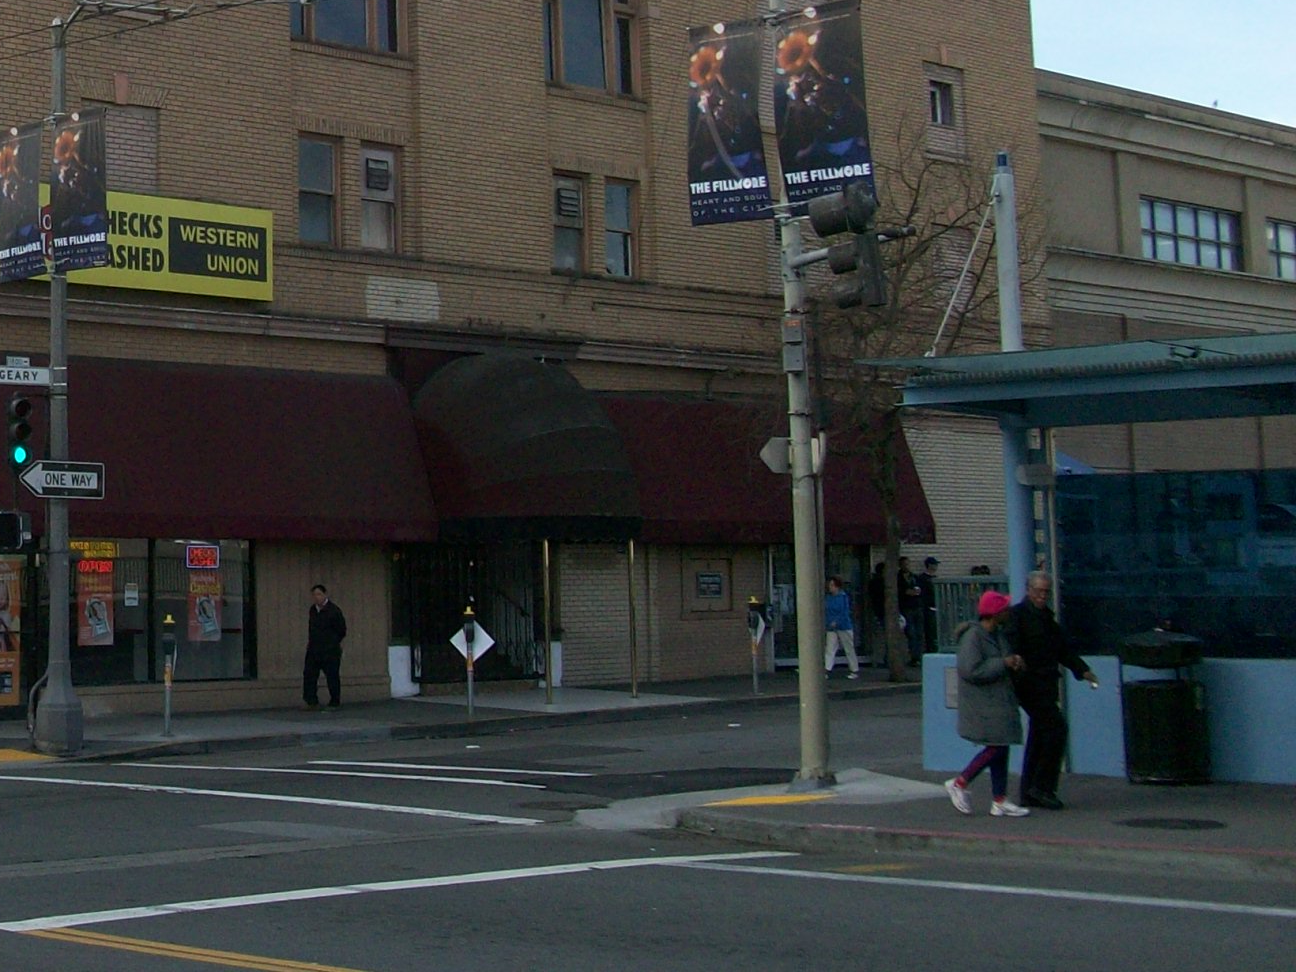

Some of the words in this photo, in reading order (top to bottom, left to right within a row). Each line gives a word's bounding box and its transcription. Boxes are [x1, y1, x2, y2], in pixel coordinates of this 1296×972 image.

[785, 171, 810, 185] THE
[810, 162, 872, 181] FILLMORE
[689, 182, 711, 195] THE
[712, 176, 768, 192] FILLMORE
[789, 187, 819, 197] HEART
[823, 184, 842, 192] AND
[692, 197, 719, 207] HEART
[722, 195, 741, 203] AND
[744, 193, 769, 201] SOUL
[106, 210, 164, 239] HECKS
[180, 224, 259, 250] WESTERN
[54, 237, 68, 247] THE
[69, 232, 106, 246] FILLMORE
[0, 249, 11, 260] THE
[11, 241, 42, 258] FILLMORE
[106, 244, 165, 272] ASHED
[207, 254, 259, 276] UNION
[0, 369, 39, 381] GEARY
[44, 473, 67, 486] ONE
[71, 474, 93, 486] WAY
[78, 560, 113, 573] OPEN
